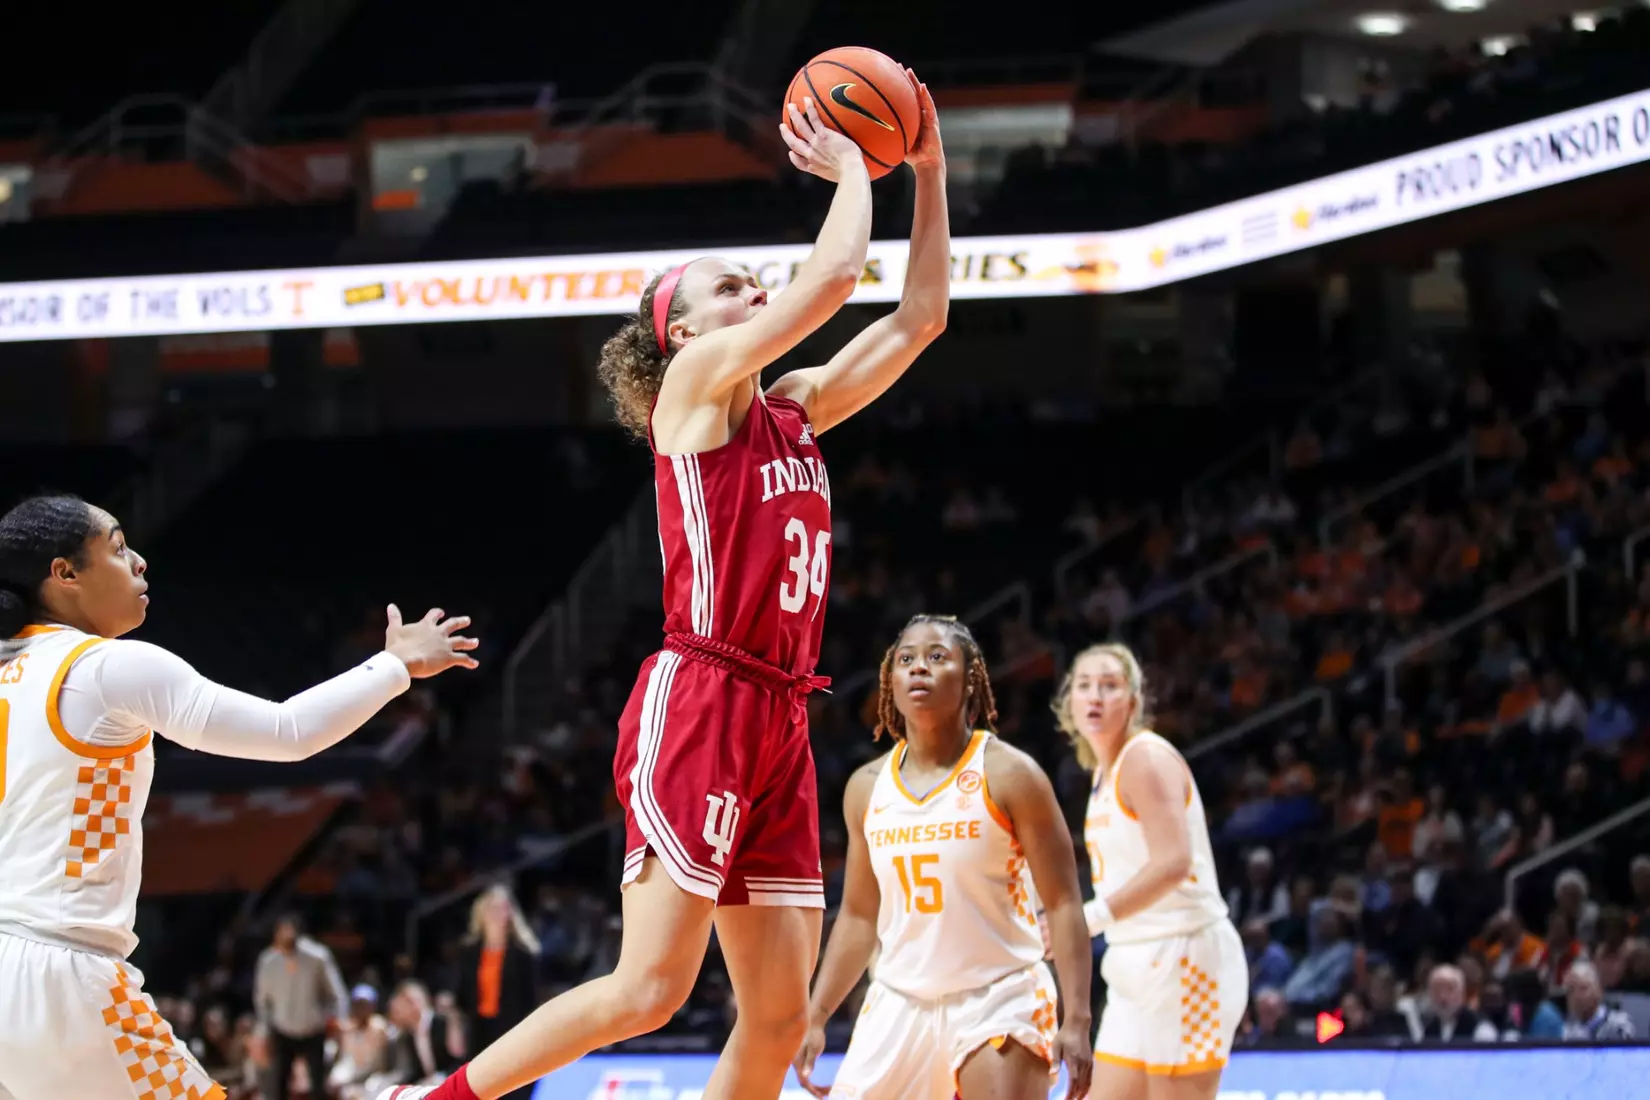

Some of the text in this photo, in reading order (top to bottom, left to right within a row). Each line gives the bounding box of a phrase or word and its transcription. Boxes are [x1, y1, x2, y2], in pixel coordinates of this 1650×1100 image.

[1396, 153, 1483, 206] PROUD
[1494, 114, 1621, 182] SPONSOR
[131, 288, 179, 319] THE
[391, 268, 646, 308] VOLUNTEER
[760, 456, 831, 510] INDIA
[779, 517, 831, 621] 34
[870, 820, 982, 848] TENNESSEE
[892, 854, 944, 913] 15
